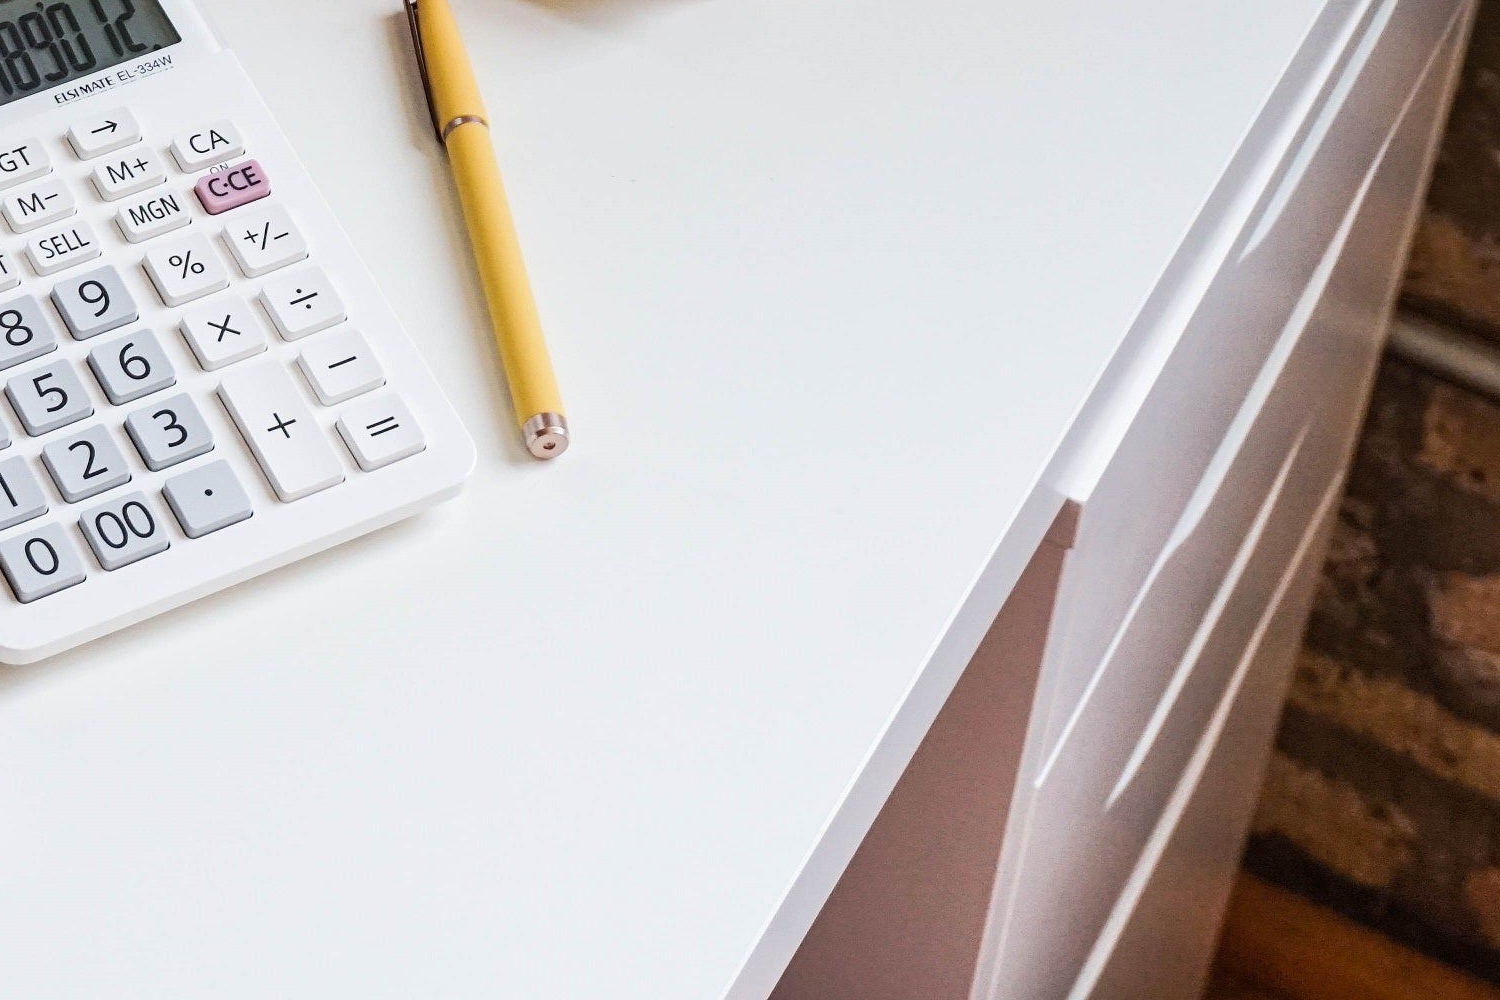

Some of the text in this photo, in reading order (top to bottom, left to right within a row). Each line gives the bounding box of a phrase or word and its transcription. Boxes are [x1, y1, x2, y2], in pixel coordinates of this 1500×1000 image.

[117, 54, 173, 82] EL-334W
[189, 129, 230, 154] CA
[106, 157, 149, 184] M+
[210, 163, 229, 174] ON
[128, 194, 181, 226] MGN
[39, 229, 91, 259] SELL
[168, 250, 205, 279] %
[78, 280, 111, 317] 9
[119, 342, 151, 380] 6
[32, 372, 69, 413] 5
[152, 409, 188, 448] 3
[267, 412, 296, 438] +
[365, 416, 399, 437] =
[68, 440, 108, 480] 2
[94, 501, 156, 549] 00
[24, 537, 60, 576] 0
